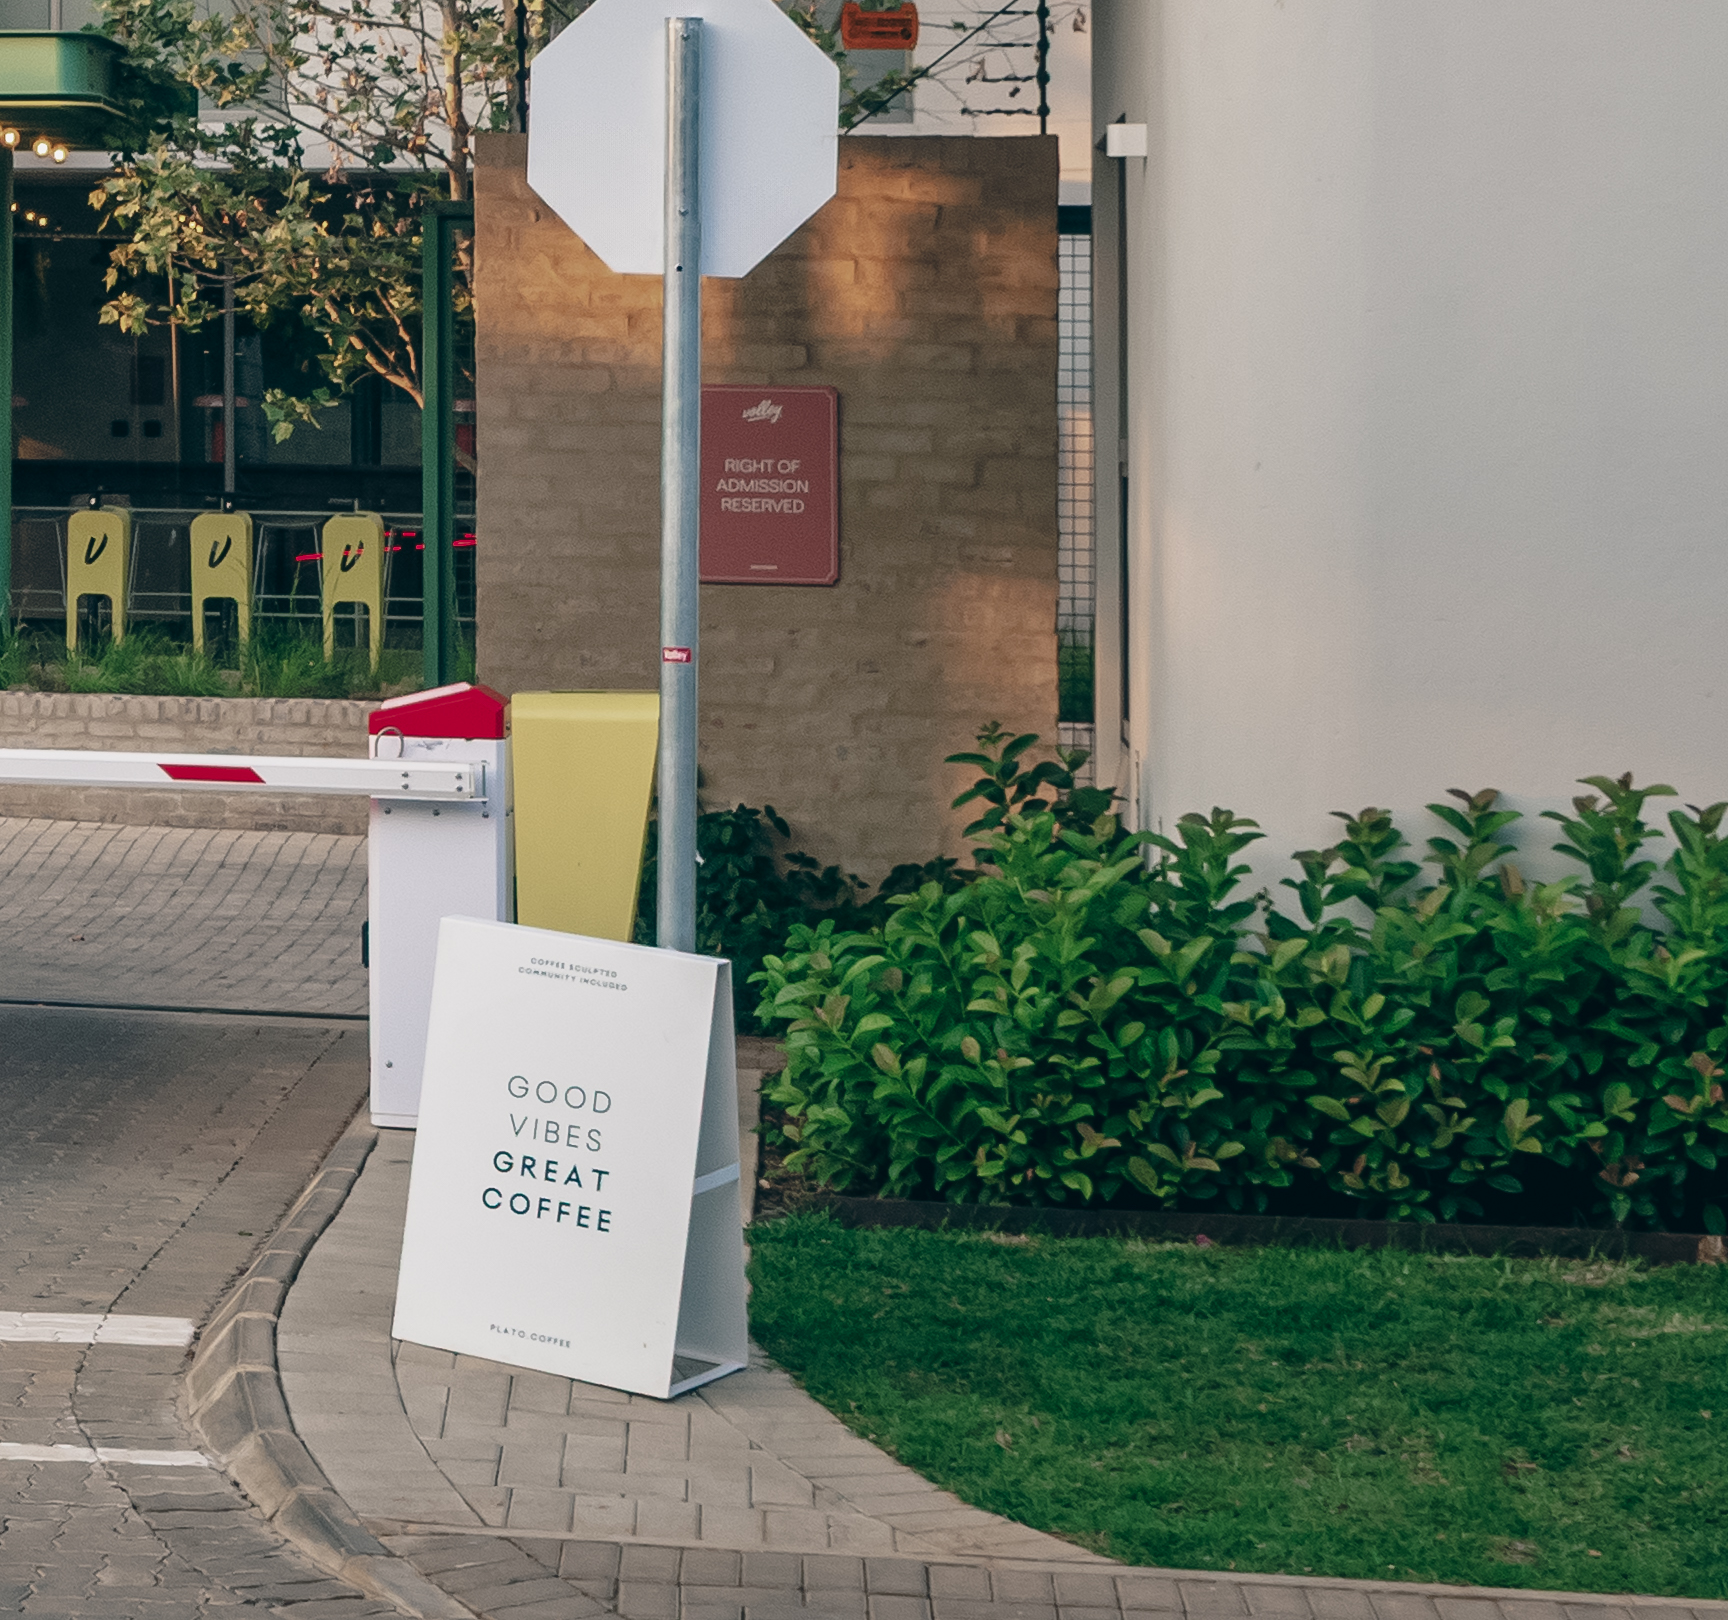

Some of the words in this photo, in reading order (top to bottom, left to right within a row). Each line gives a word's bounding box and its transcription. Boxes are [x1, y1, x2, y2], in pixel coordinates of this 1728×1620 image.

[724, 458, 774, 474] RIGHT
[777, 459, 801, 474] OF
[716, 479, 809, 494] ADMISSION
[721, 498, 805, 514] RESERVED
[518, 966, 577, 982] COMMUNITY
[579, 977, 628, 991] INCLUDED
[530, 957, 566, 970] COFFEE
[569, 963, 618, 978] SCULPTED
[507, 1075, 612, 1114] GOOD
[509, 1113, 602, 1152] VIBES
[493, 1150, 610, 1192] GREAT
[482, 1187, 612, 1233] COFFEE
